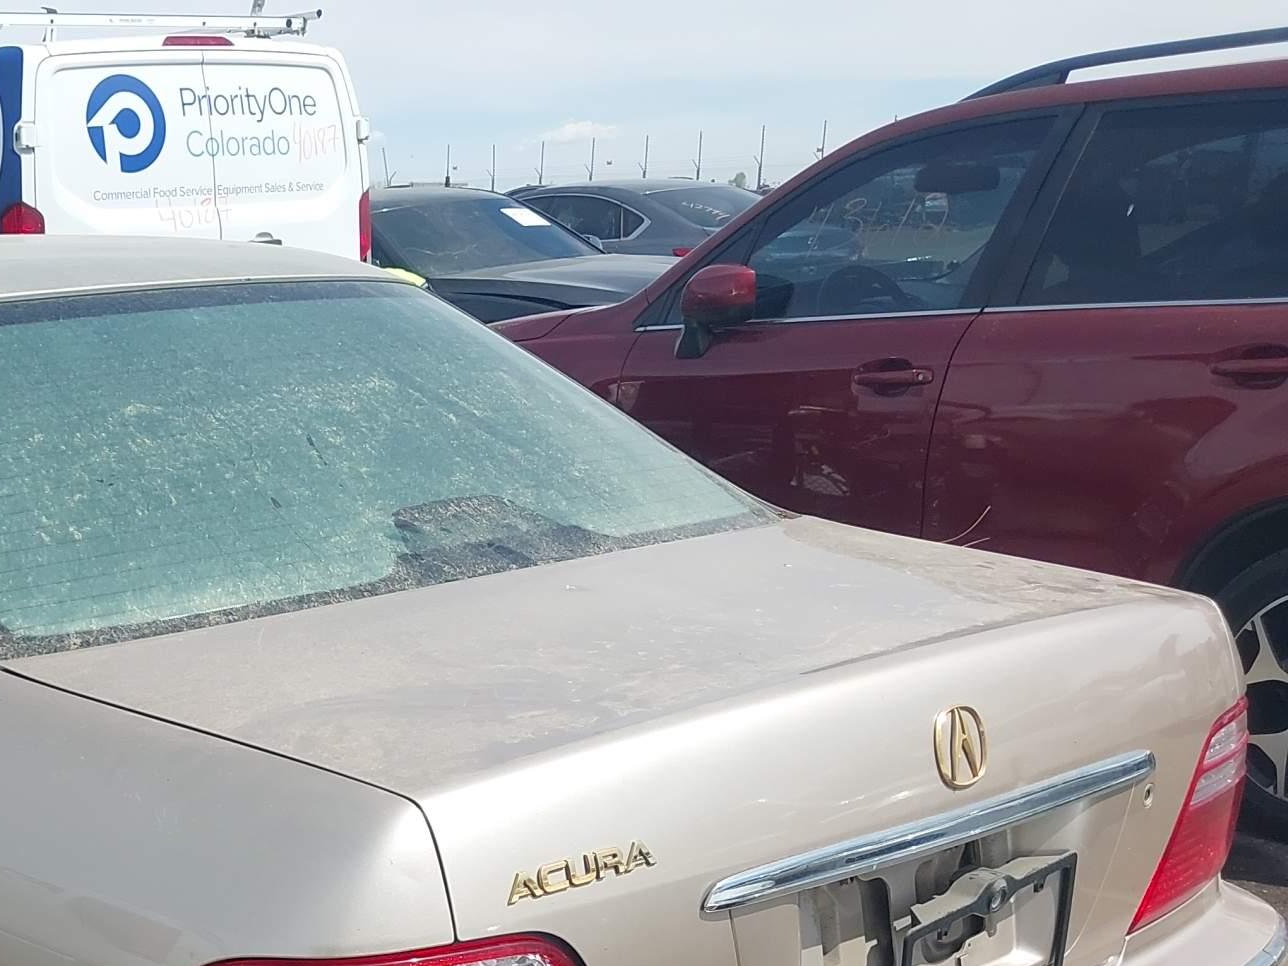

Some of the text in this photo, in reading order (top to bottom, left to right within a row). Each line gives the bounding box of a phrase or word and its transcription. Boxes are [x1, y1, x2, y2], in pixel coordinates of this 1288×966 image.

[179, 86, 317, 123] PriorityOne
[186, 129, 291, 157] Colorado
[93, 180, 324, 201] Commercial Food Service Equipment Sales & Service
[507, 840, 657, 906] ACURA
